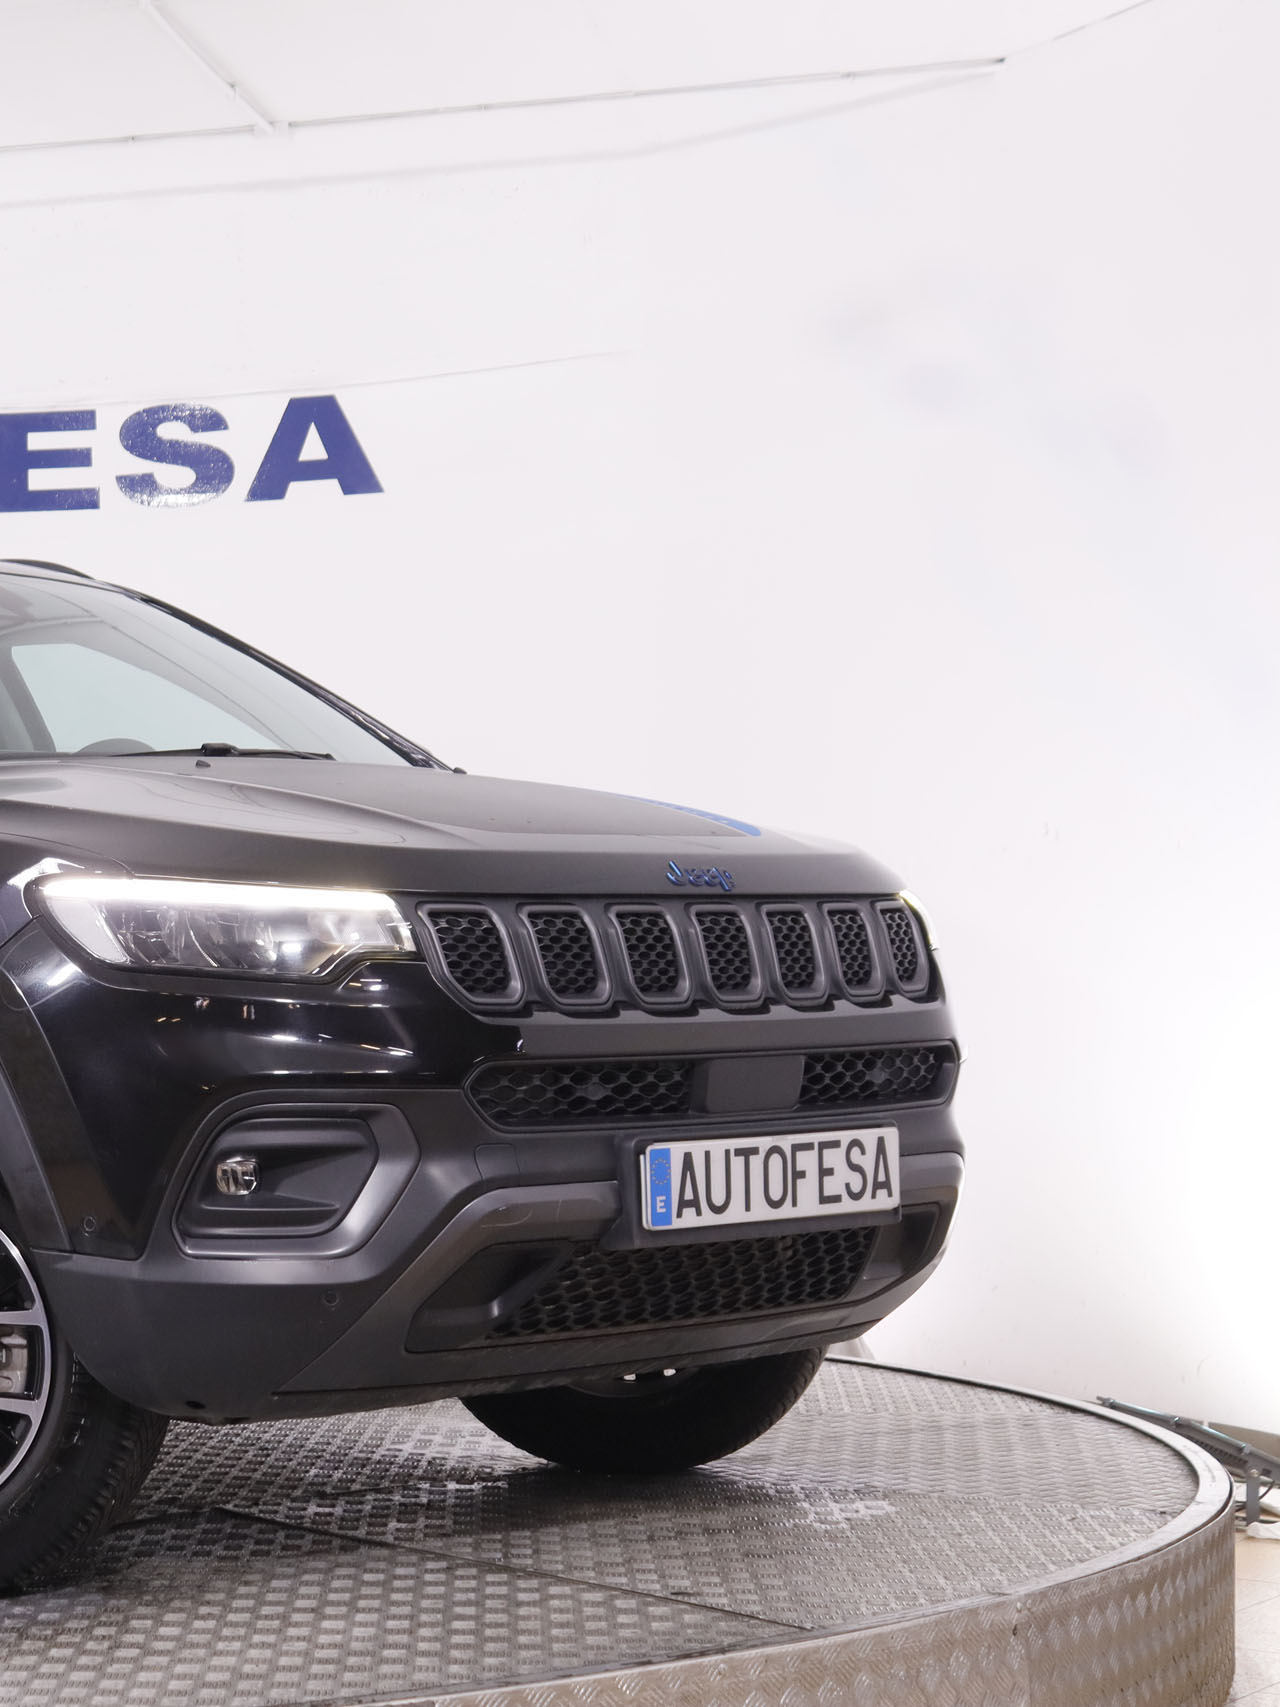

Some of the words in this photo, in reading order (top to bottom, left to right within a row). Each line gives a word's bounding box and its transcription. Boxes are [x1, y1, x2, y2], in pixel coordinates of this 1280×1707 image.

[666, 860, 733, 892] Jeep
[676, 1136, 893, 1219] AUTOFESA
[656, 1195, 666, 1213] E
